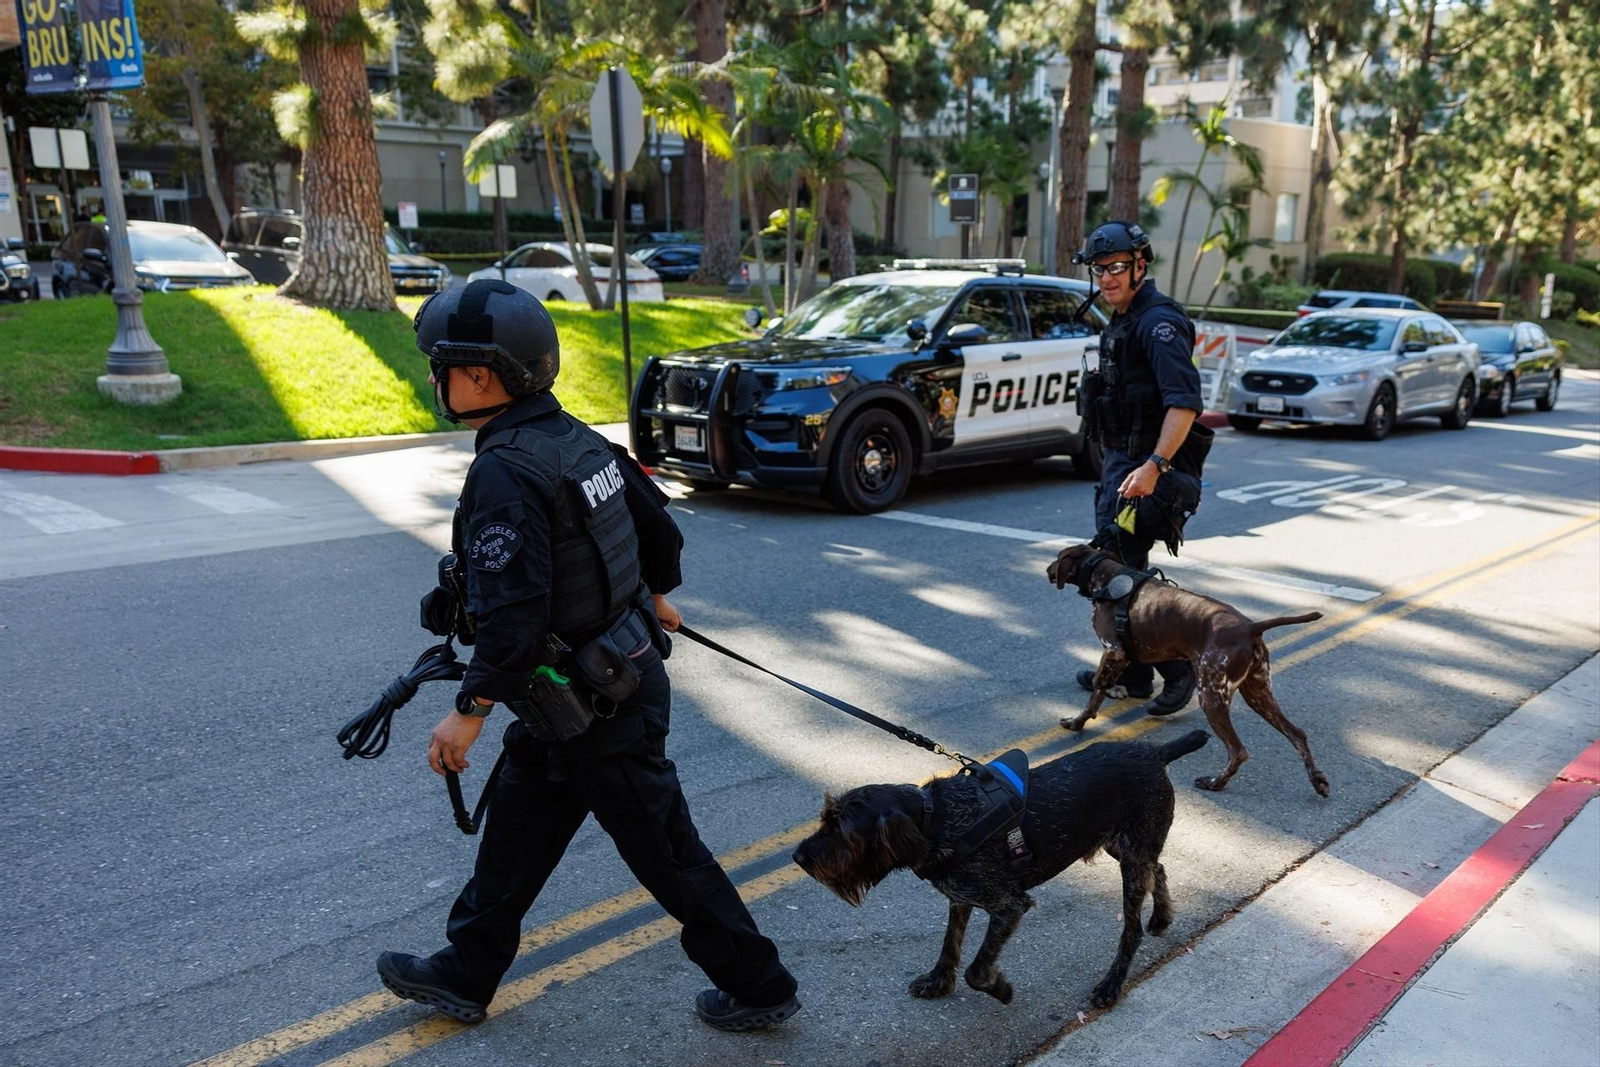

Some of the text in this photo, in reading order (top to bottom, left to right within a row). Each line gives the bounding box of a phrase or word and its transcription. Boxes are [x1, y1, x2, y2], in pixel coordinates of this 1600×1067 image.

[21, 0, 57, 25] GO
[27, 17, 135, 68] BRU INS!
[968, 369, 1079, 418] POLICE
[804, 414, 823, 426] 25
[471, 526, 517, 559] LOS ANGELES
[481, 537, 504, 554] BOMB
[487, 546, 501, 559] K-9
[485, 550, 511, 569] POLICE
